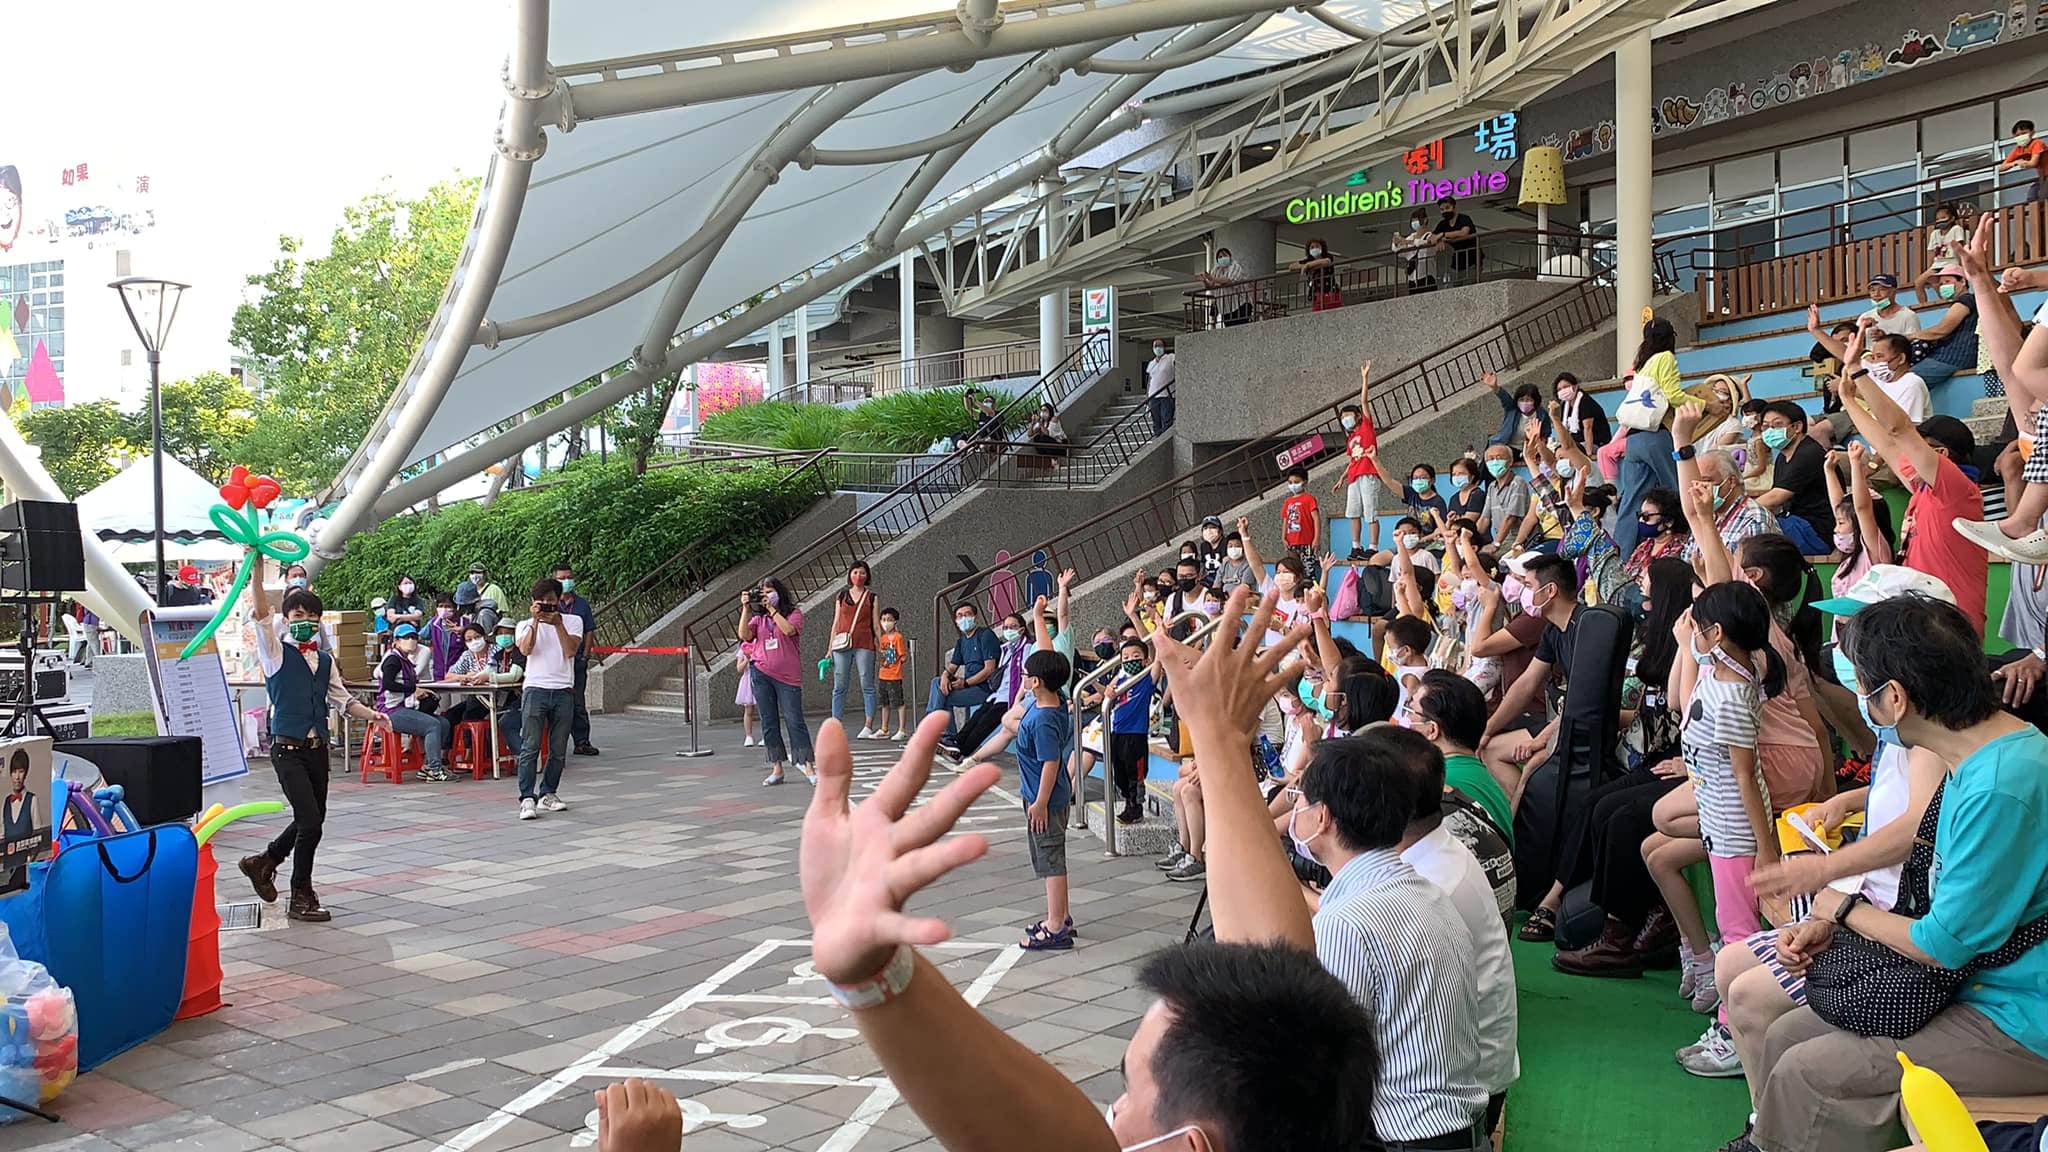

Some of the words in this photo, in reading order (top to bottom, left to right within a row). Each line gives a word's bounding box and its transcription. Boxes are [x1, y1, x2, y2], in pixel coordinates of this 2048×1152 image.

[62, 163, 89, 186] 如果
[1286, 180, 1403, 224] Children's
[1408, 170, 1508, 205] Theatre
